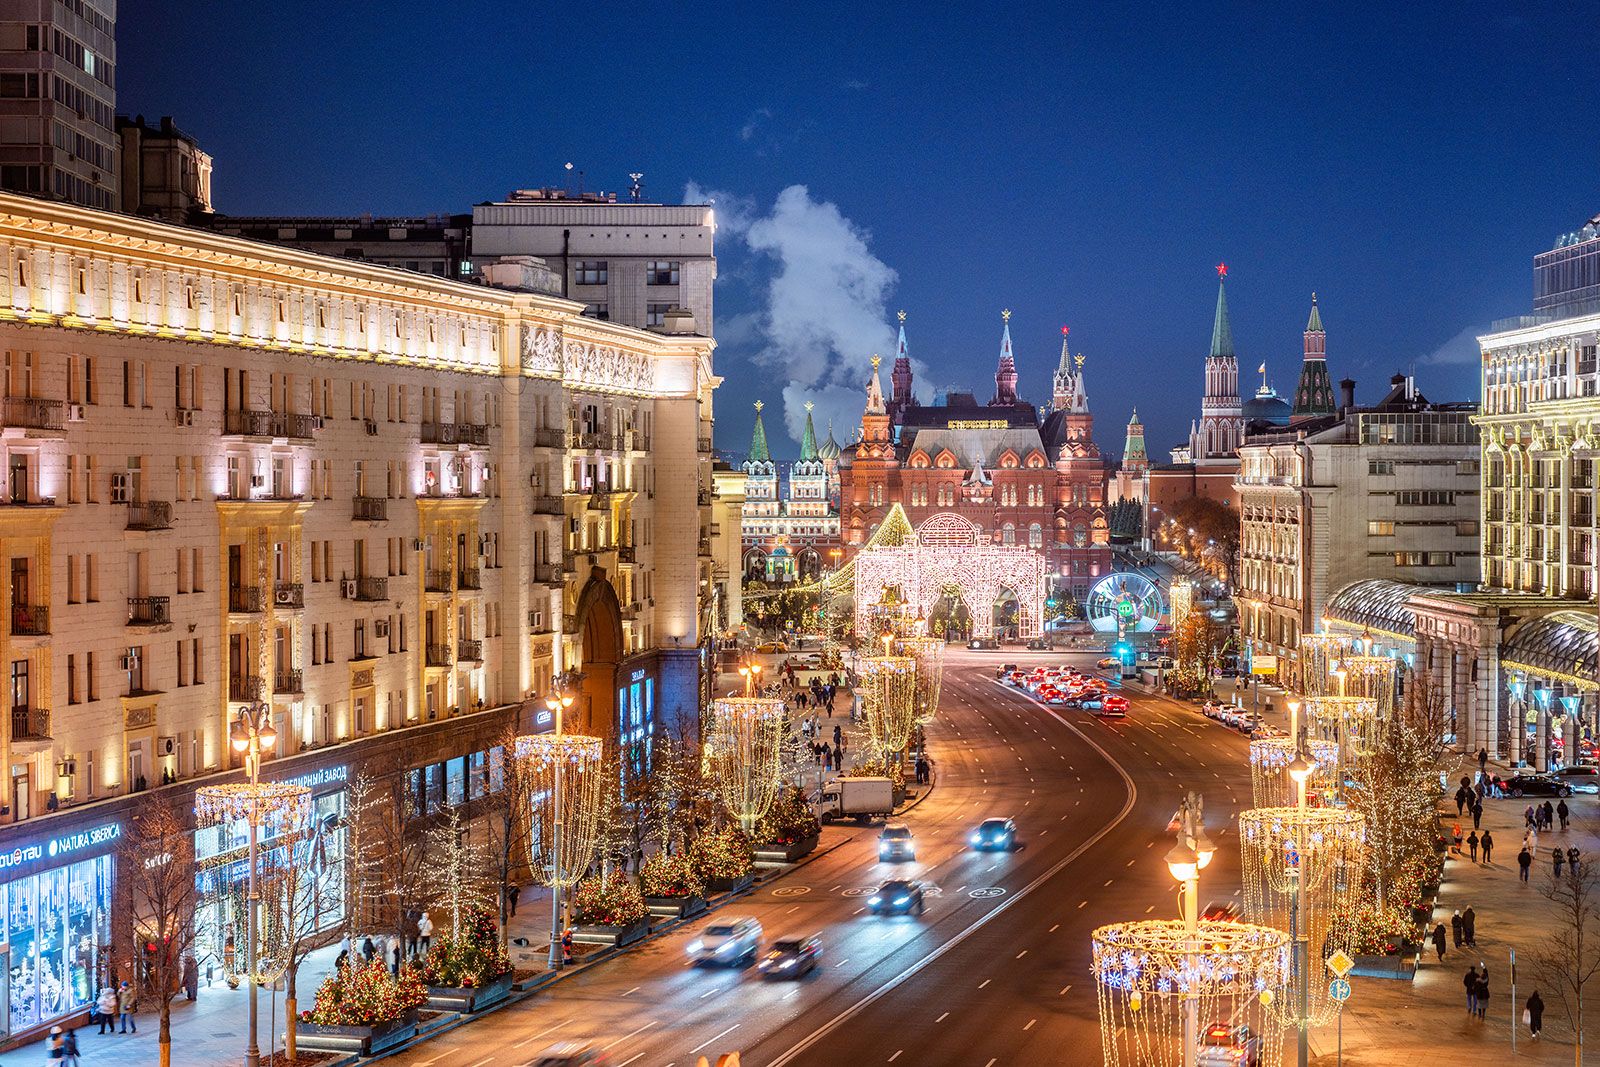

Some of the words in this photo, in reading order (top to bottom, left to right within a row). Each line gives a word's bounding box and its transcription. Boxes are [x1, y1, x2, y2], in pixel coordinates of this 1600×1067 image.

[279, 769, 323, 788] ЕЛИРНЫЙ
[324, 765, 347, 783] ЗАВОД
[59, 832, 89, 854] NATURA
[90, 823, 120, 845] SIBERICA
